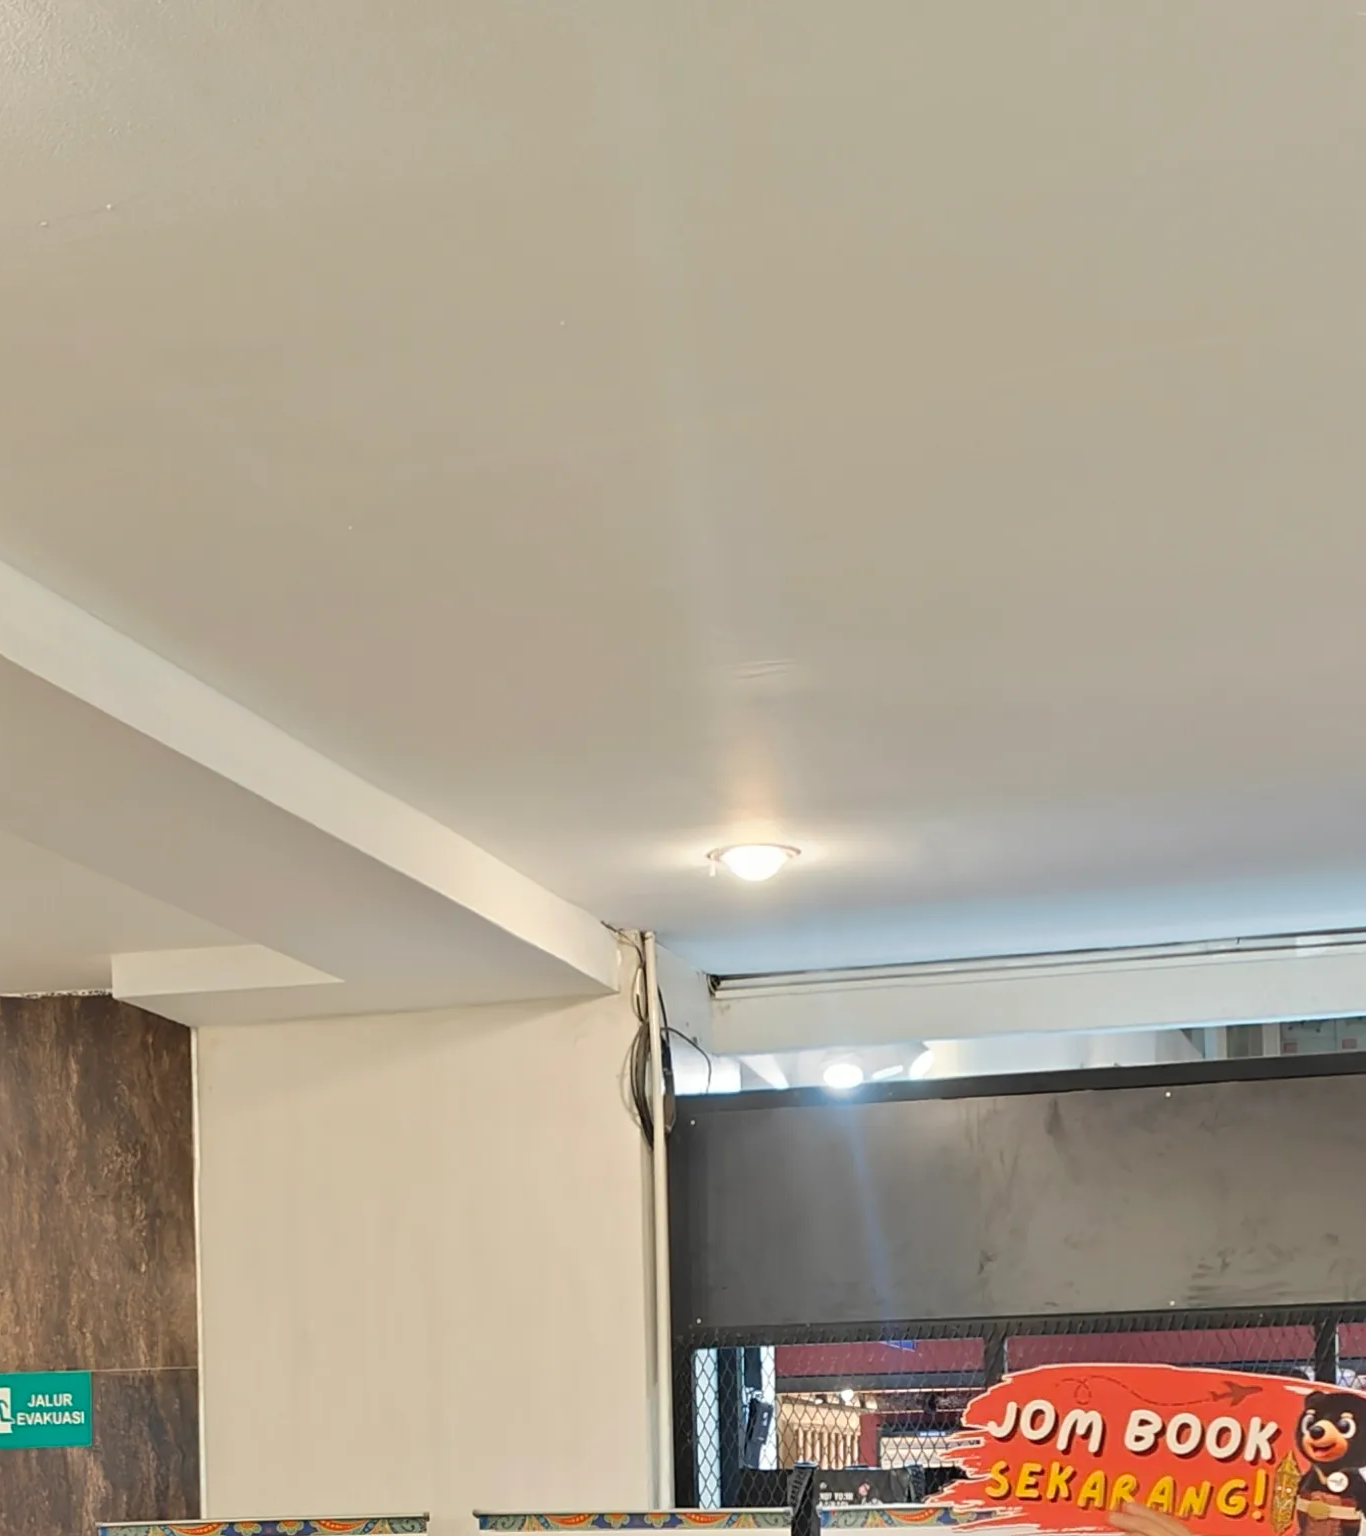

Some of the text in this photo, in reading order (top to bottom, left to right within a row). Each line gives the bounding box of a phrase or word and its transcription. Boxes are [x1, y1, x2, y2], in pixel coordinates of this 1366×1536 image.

[17, 1411, 85, 1425] EVAKUASI
[27, 1393, 73, 1407] JALUR
[987, 1399, 1280, 1462] JOM BOOK
[985, 1461, 1266, 1520] SEKARANG!
